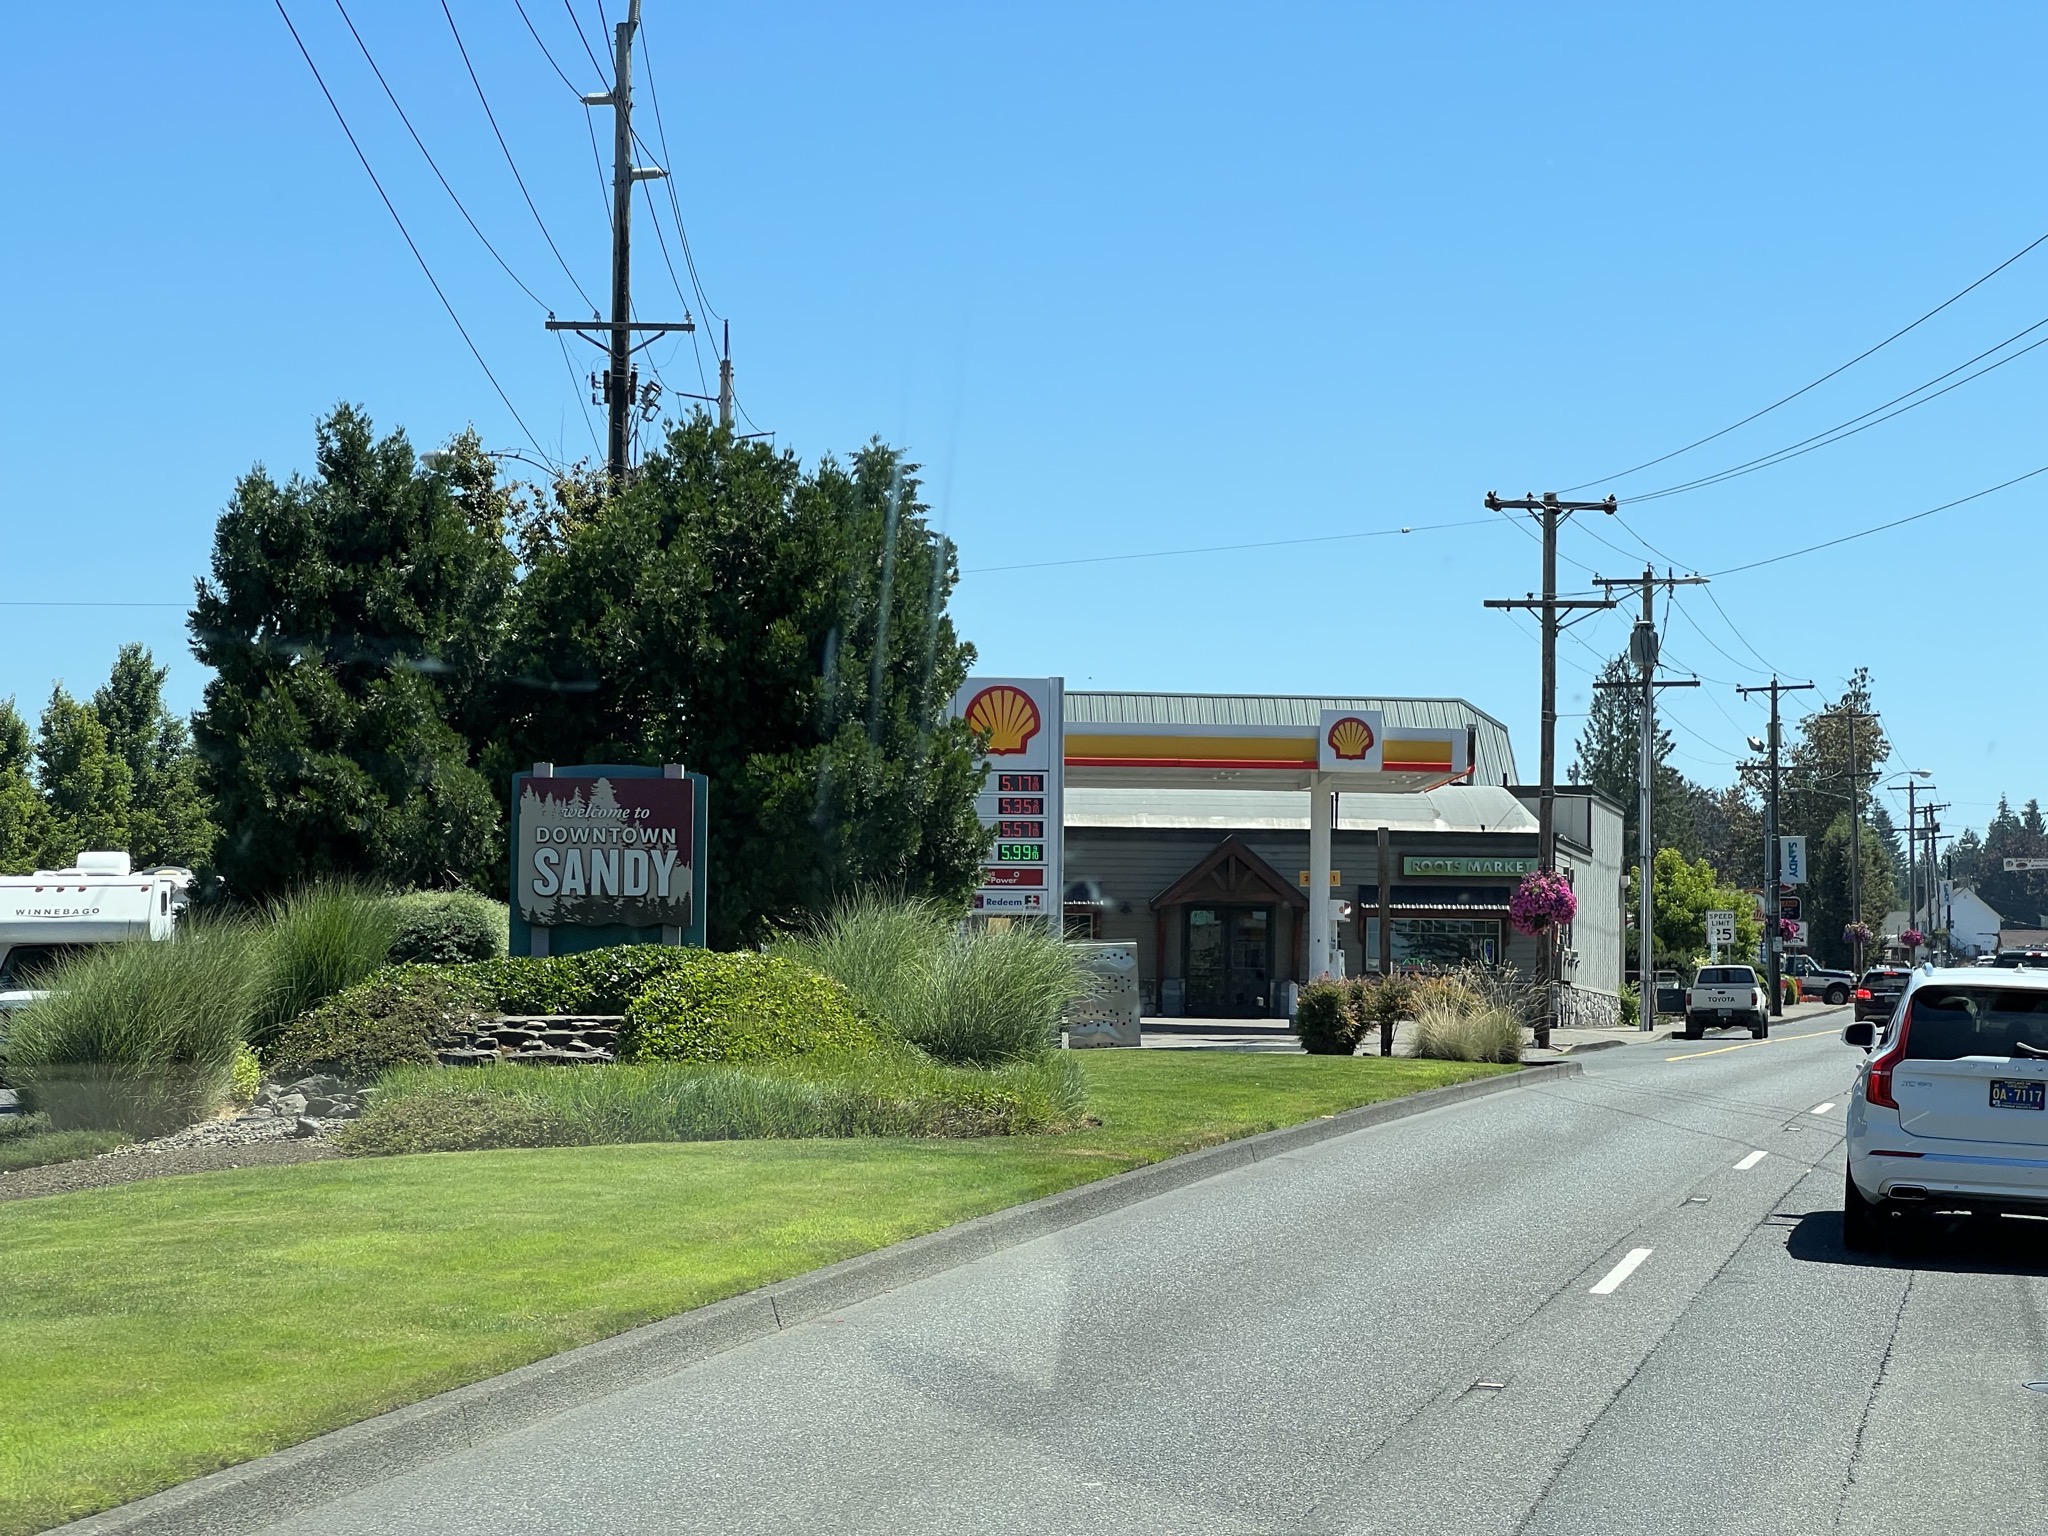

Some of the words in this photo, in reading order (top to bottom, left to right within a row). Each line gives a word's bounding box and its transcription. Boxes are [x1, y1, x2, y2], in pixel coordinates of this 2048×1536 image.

[1002, 776, 1031, 791] 5.17
[562, 804, 630, 819] welcome
[634, 806, 650, 819] to
[1002, 799, 1032, 814] 5.35
[536, 827, 676, 844] DOWNTOWN
[1002, 822, 1031, 837] 5.57
[1001, 845, 1031, 860] 5.99
[1788, 842, 1798, 878] SANDY
[533, 847, 678, 897] SANDY
[1412, 860, 1461, 873] ROOTS
[1467, 861, 1532, 873] MARKET
[986, 898, 1022, 906] Redeem
[15, 907, 100, 916] WINNEBAGO
